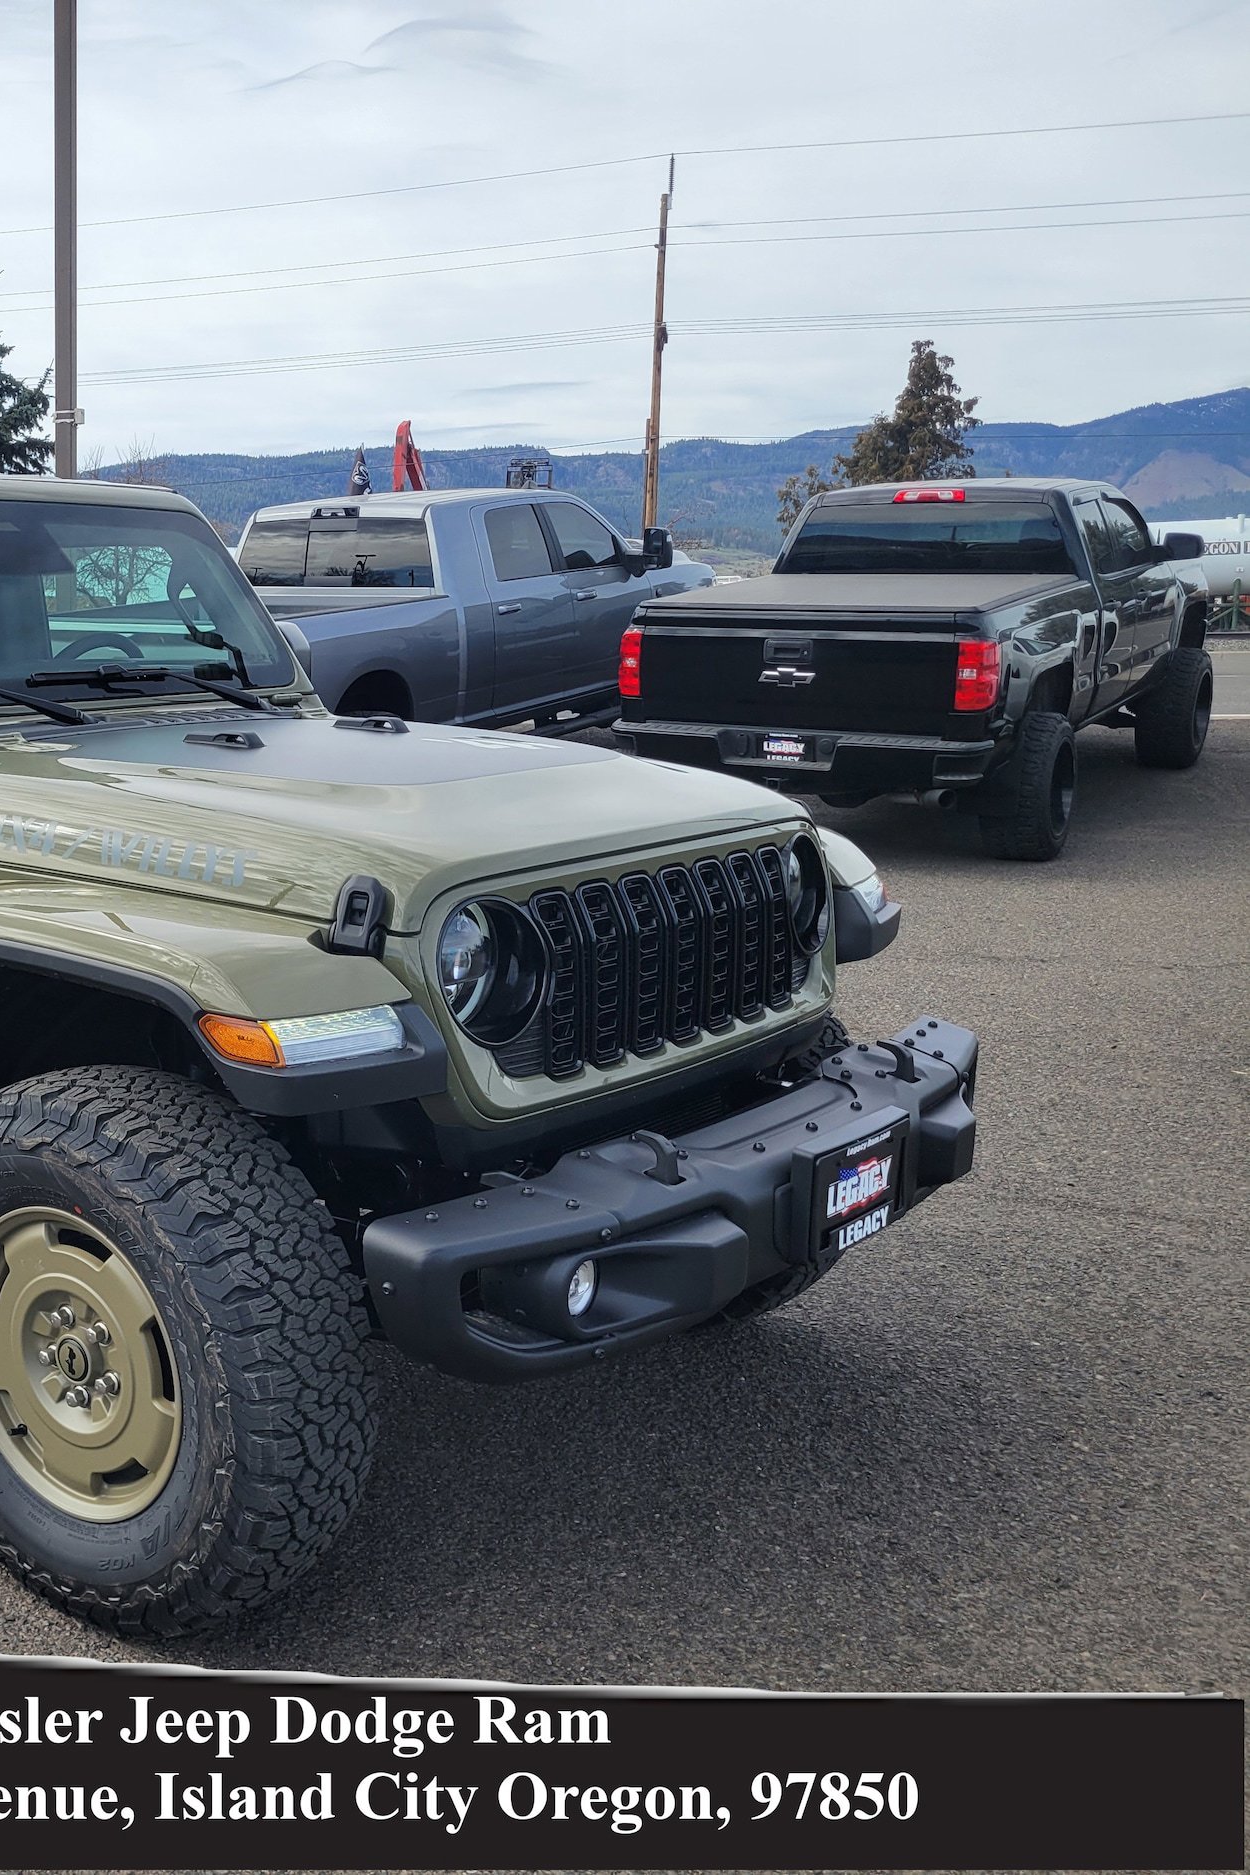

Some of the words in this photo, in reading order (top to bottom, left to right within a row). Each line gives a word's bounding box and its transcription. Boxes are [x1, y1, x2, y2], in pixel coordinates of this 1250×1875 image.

[763, 741, 805, 753] LEGACY
[100, 826, 258, 888] WILLYS
[827, 1157, 892, 1217] LEGACY
[838, 1204, 889, 1251] LEGACY
